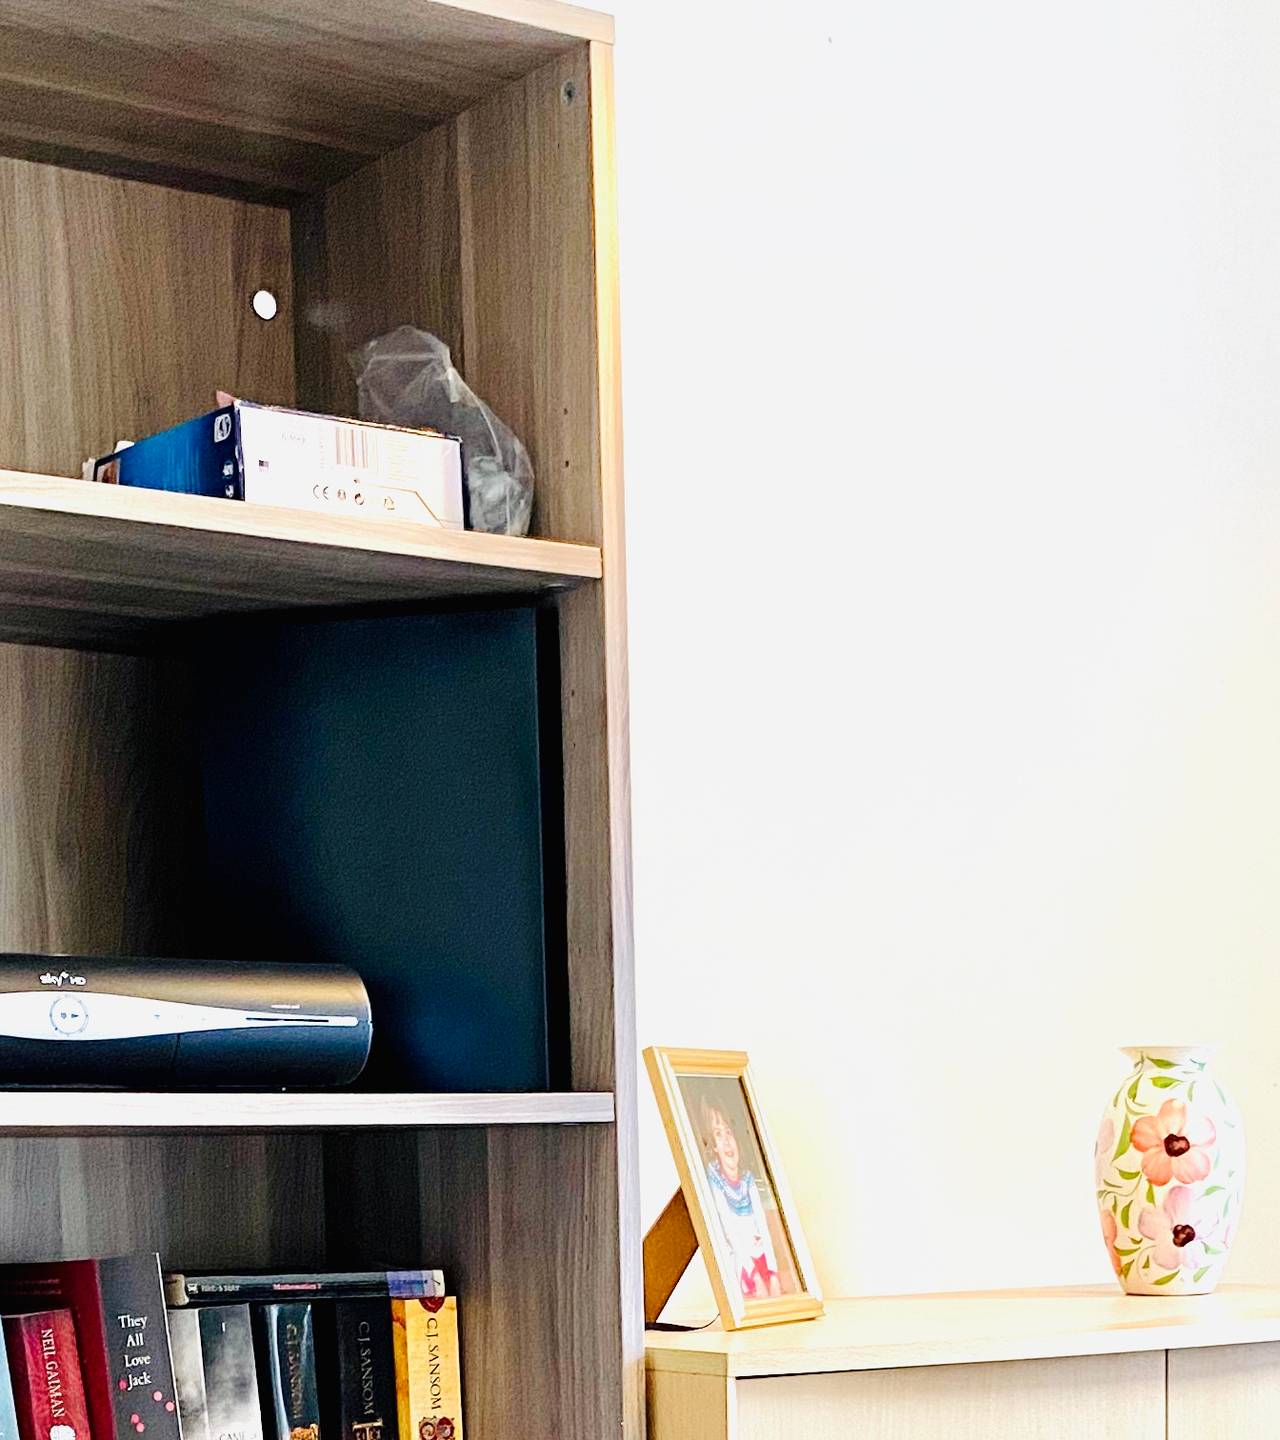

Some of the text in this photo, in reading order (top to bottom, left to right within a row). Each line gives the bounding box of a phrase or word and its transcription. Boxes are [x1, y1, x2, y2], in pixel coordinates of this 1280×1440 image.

[118, 1314, 148, 1330] They
[126, 1332, 145, 1348] All
[124, 1354, 152, 1368] Love
[41, 1328, 66, 1418] NEIL GAIMAN
[127, 1371, 152, 1391] Jack
[359, 1347, 375, 1415] SANSOM
[427, 1341, 442, 1411] SANSOM
